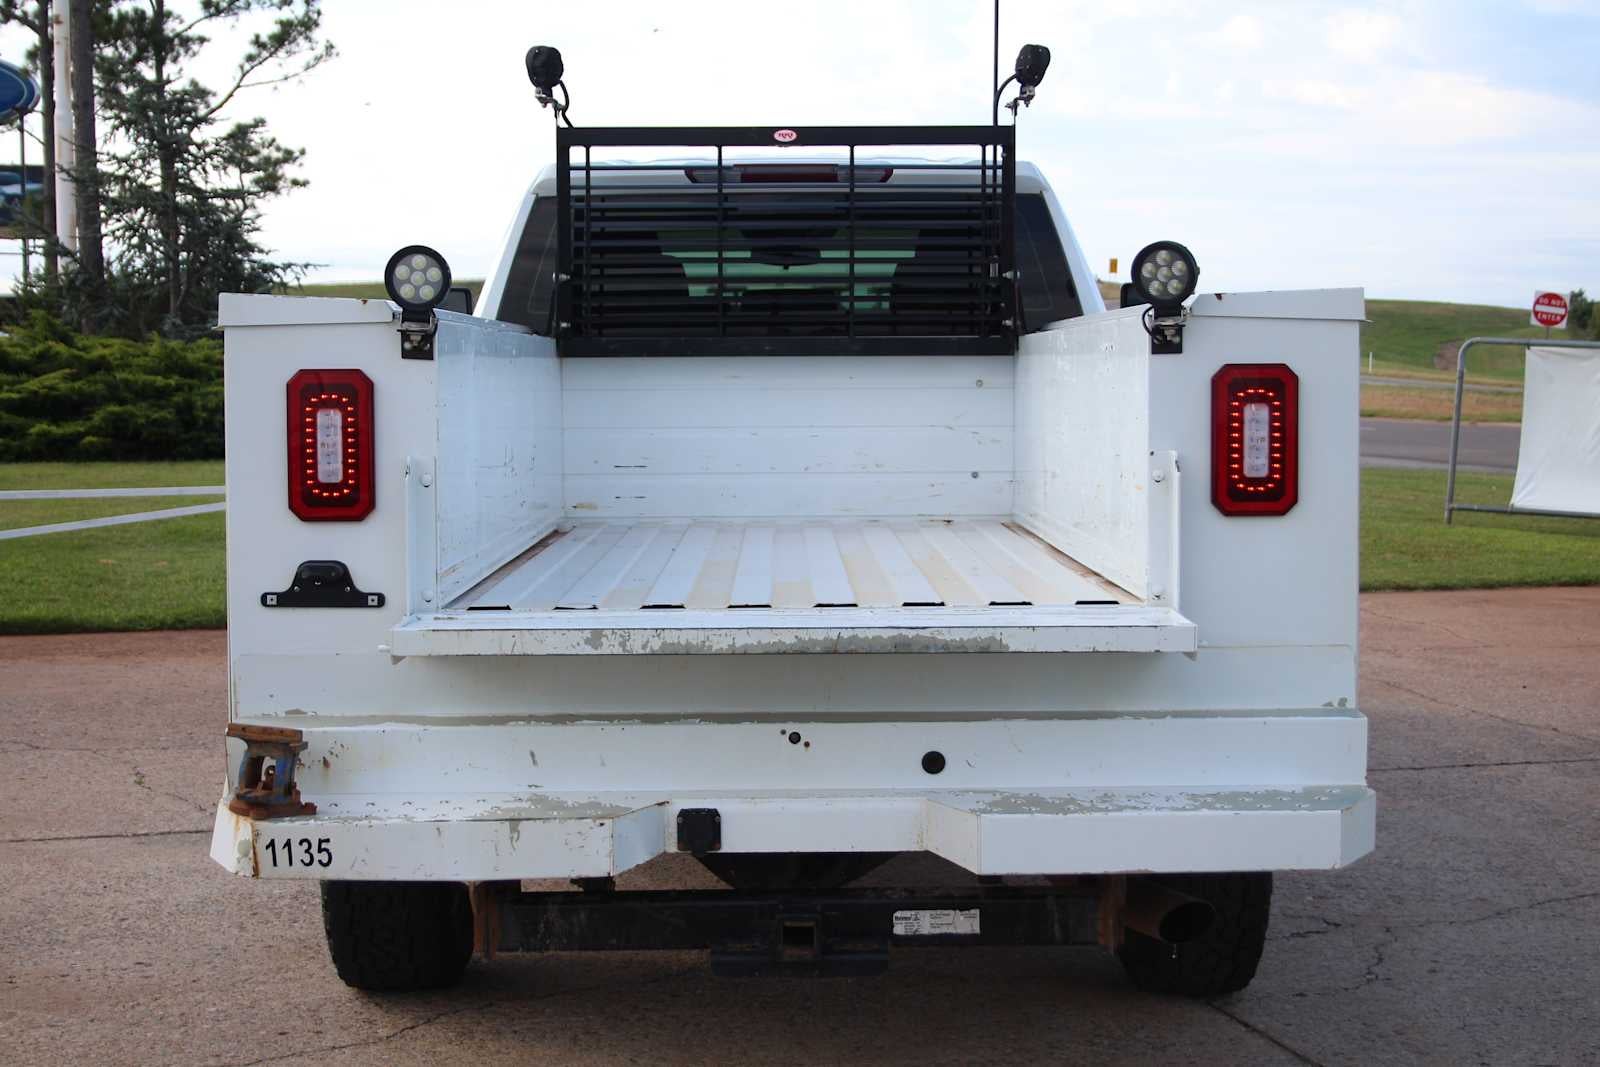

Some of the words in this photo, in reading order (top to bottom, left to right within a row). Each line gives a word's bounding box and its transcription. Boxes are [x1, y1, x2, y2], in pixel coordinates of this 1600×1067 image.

[1539, 297, 1549, 305] DO
[1551, 299, 1565, 307] NOT
[1537, 312, 1562, 321] ENTER
[265, 838, 333, 867] 1135
